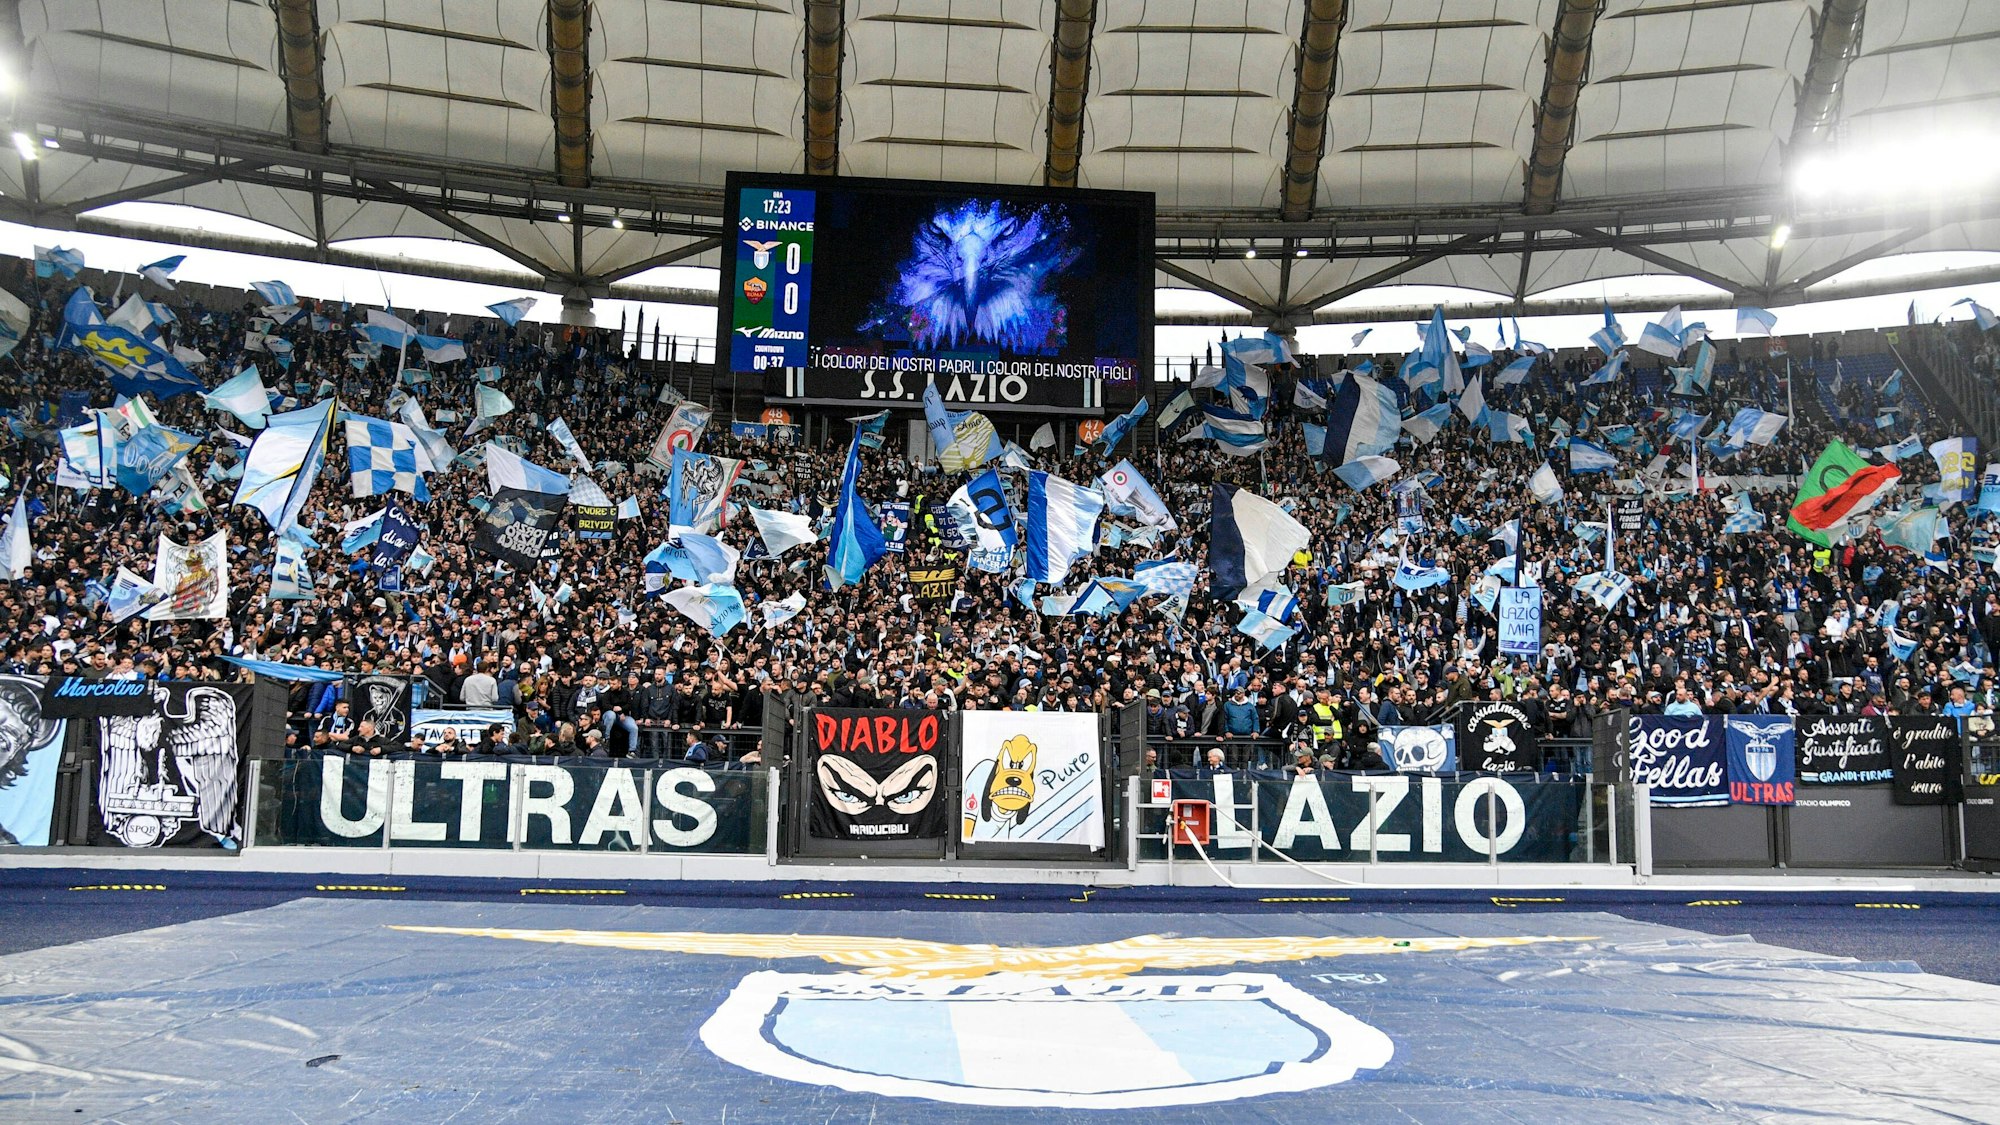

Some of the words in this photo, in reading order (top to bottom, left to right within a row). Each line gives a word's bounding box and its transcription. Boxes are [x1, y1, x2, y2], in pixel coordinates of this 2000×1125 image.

[763, 200, 791, 214] 17:23
[756, 220, 814, 231] BINANCE
[786, 243, 800, 275] 0
[784, 282, 798, 315] 0
[822, 354, 866, 369] COLORI
[870, 356, 889, 370] DEI
[893, 358, 936, 372] NOSTRI
[980, 361, 984, 374] I
[987, 361, 1031, 376] COLORI
[1034, 363, 1053, 377] DEI
[1057, 364, 1100, 378] NOSTRI
[1103, 366, 1132, 380] FIGLI
[860, 371, 915, 400] S.S.
[768, 409, 783, 418] 48
[1085, 420, 1099, 430] 47
[1084, 431, 1099, 440] AS
[579, 520, 614, 529] BRIVIDI
[1515, 591, 1531, 604] LA
[1501, 606, 1540, 620] LAZIO
[1508, 623, 1535, 637] MIA
[54, 677, 144, 697] Marcolino
[815, 713, 938, 753] DIABLO
[1802, 717, 1874, 737] Assenti
[1902, 722, 1953, 749] gradito
[1801, 735, 1884, 769] Giustificati
[1482, 757, 1515, 772] lazio
[1819, 769, 1894, 784] GRANDI-FIRME
[1730, 781, 1795, 803] ULTRAS
[1911, 780, 1942, 794] scuro
[320, 755, 717, 847] ULTRAS
[1819, 800, 1850, 808] OLIMPICO
[1213, 773, 1526, 854] LAZIO
[129, 825, 156, 836] SPQR
[850, 823, 909, 835] IRRIDUCIBILI
